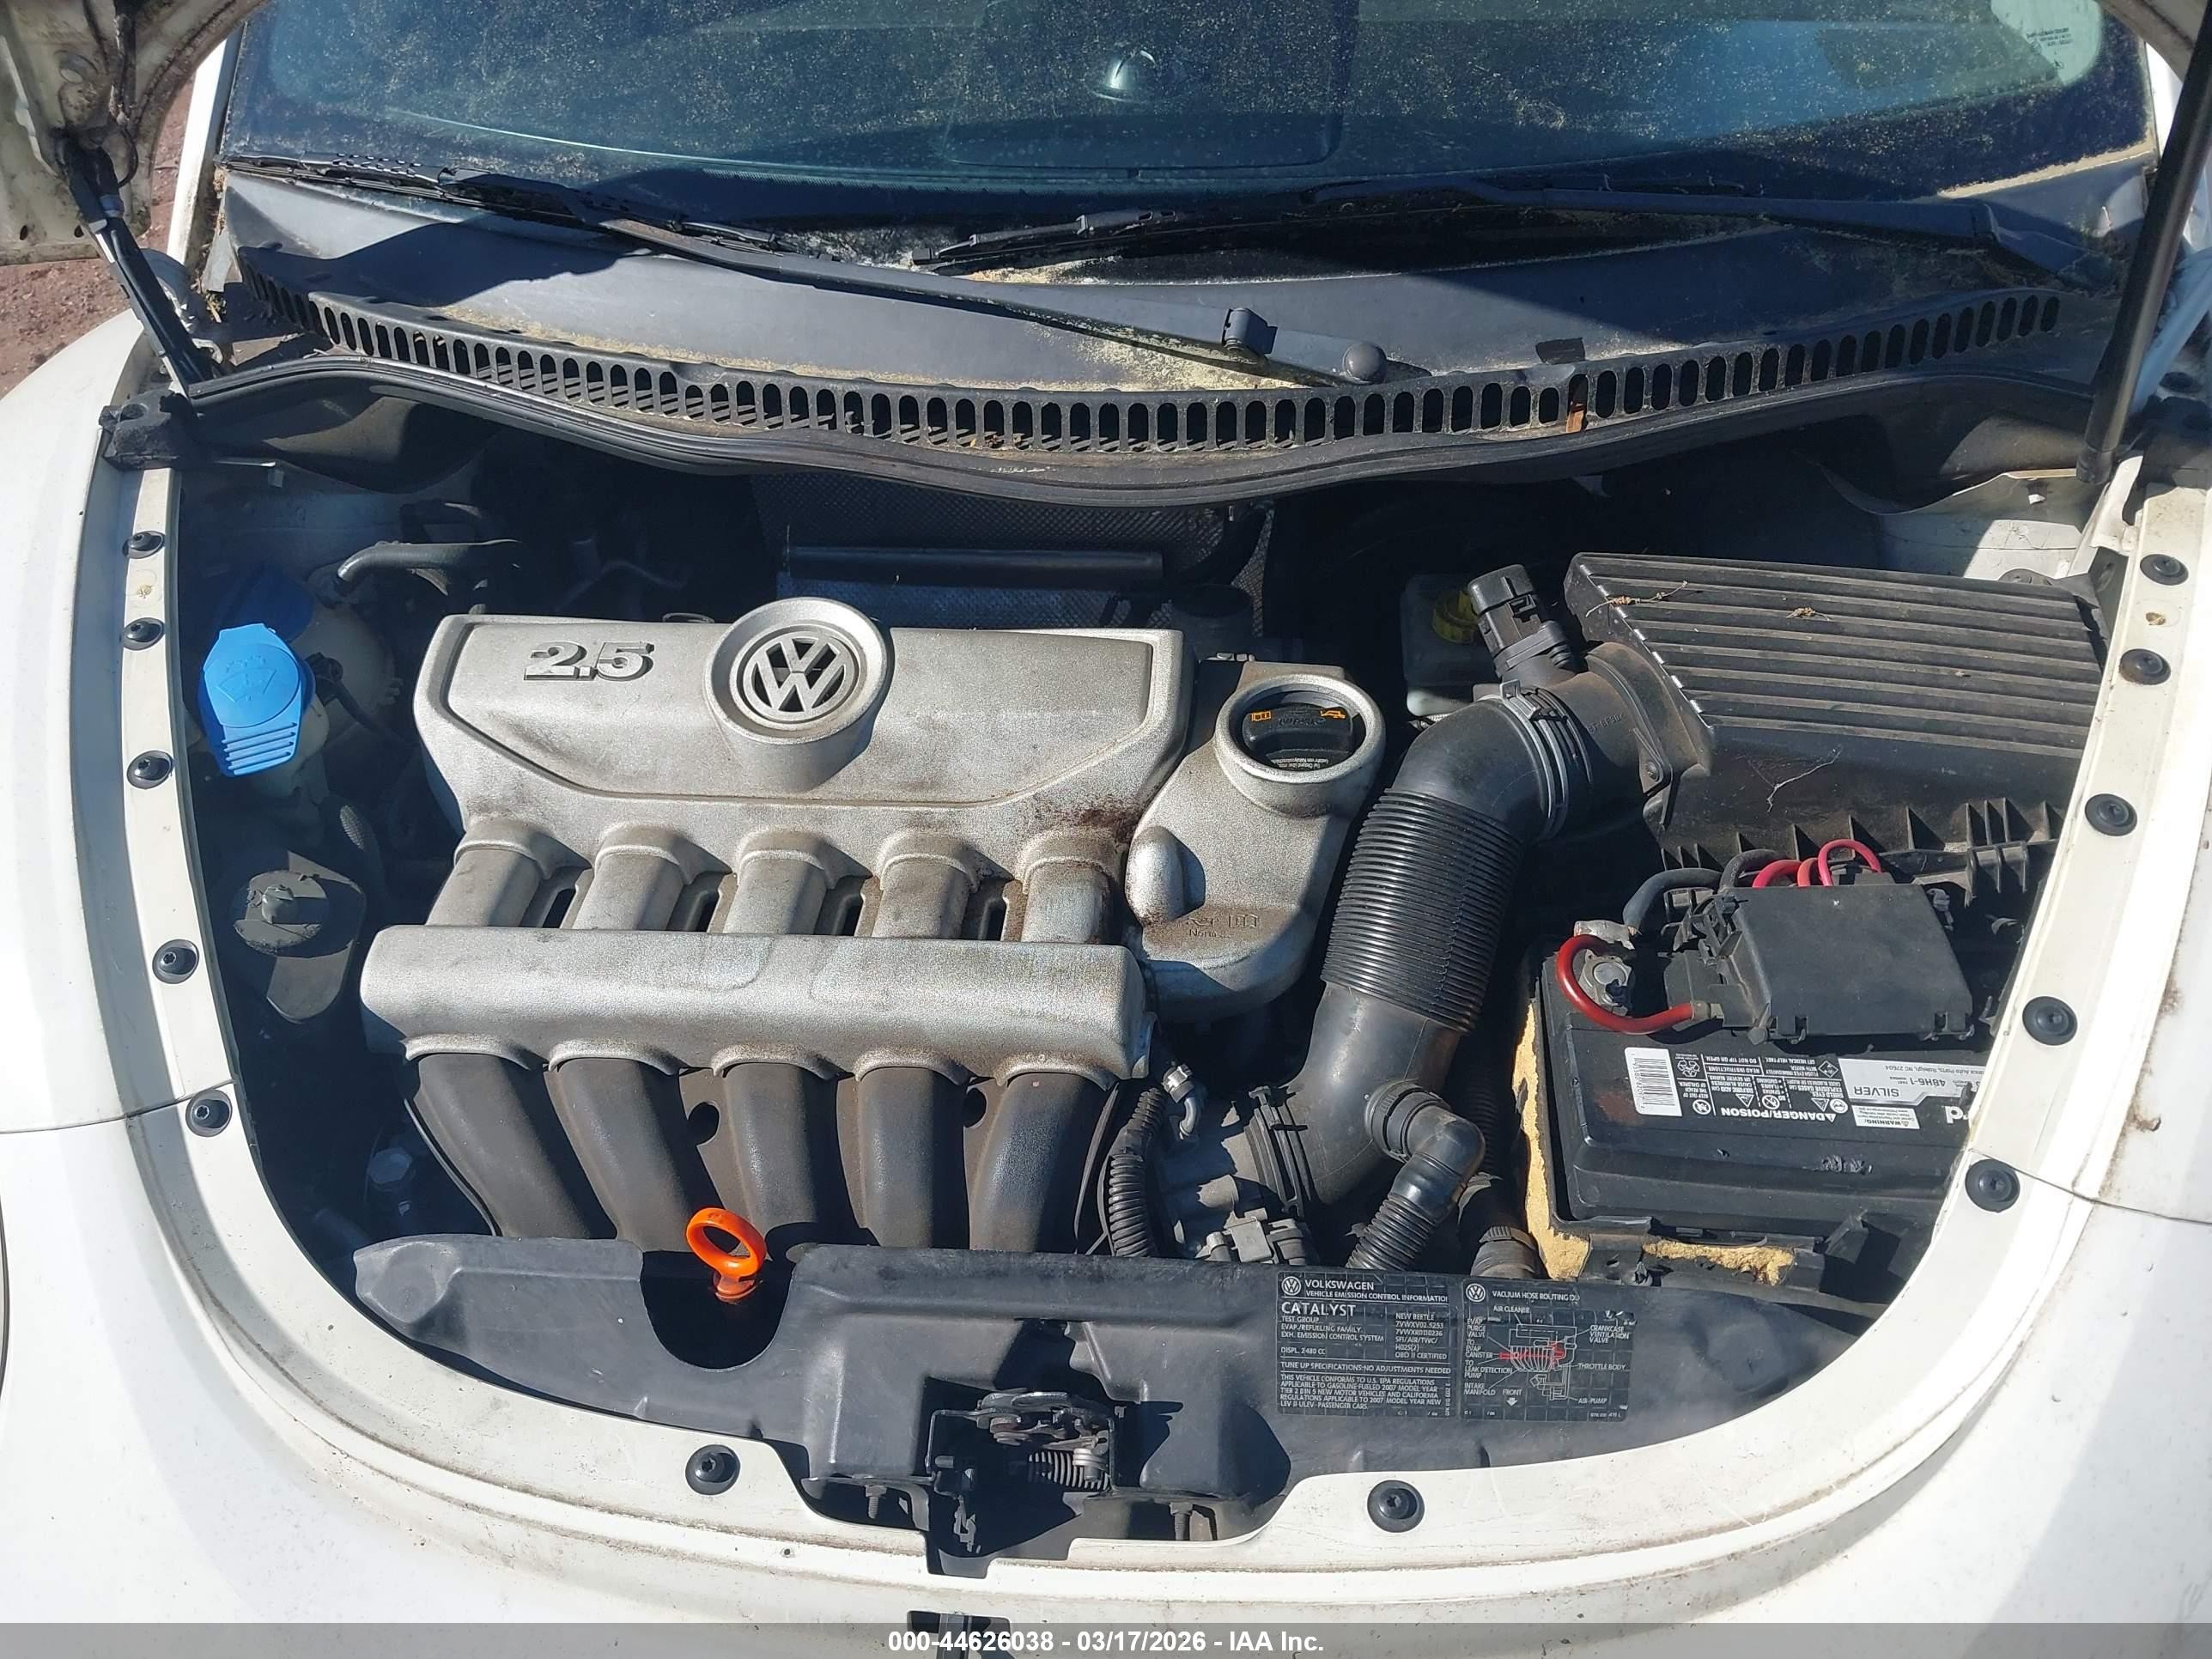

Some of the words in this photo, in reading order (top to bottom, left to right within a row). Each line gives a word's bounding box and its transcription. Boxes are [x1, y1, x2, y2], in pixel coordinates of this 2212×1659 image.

[524, 641, 654, 681] 2.5
[1910, 1078, 1946, 1087] 48H6-1
[1854, 1086, 1899, 1097] SILVER
[1721, 1108, 1826, 1121] DANGER/POISON
[1304, 1279, 1374, 1291] VOLKSWAGEN
[1281, 1302, 1356, 1316] CATALYST
